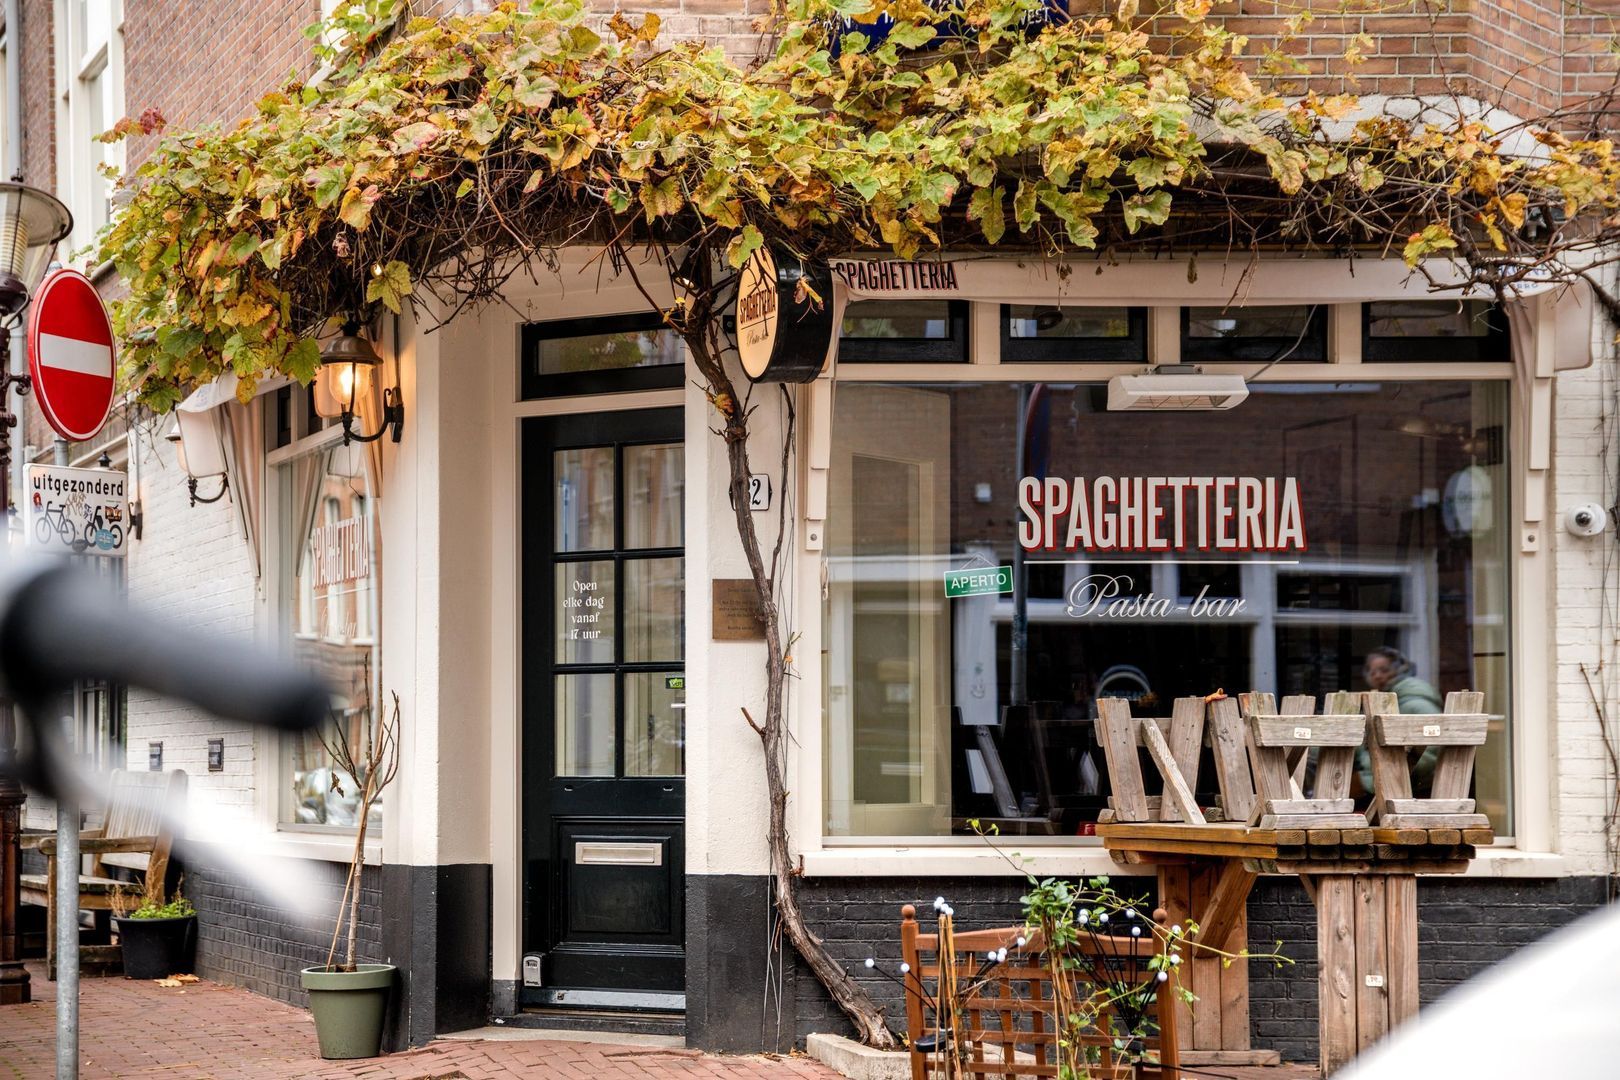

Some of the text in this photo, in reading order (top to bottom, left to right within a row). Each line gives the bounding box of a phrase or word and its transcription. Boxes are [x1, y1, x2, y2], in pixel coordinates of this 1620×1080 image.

[835, 260, 959, 292] SPAGHETTERIA
[739, 285, 777, 326] SPAGHETTERIA
[33, 474, 124, 497] uitgezonderd
[1018, 475, 1308, 553] SPAGHETTERIA
[310, 514, 370, 590] SPAGHETTERIA
[572, 580, 598, 594] Open
[951, 572, 1007, 590] APERTO
[562, 596, 605, 610] elke dag
[1066, 573, 1248, 618] Pasta-bar
[571, 611, 601, 624] vanaf
[570, 628, 601, 640] 17 uur
